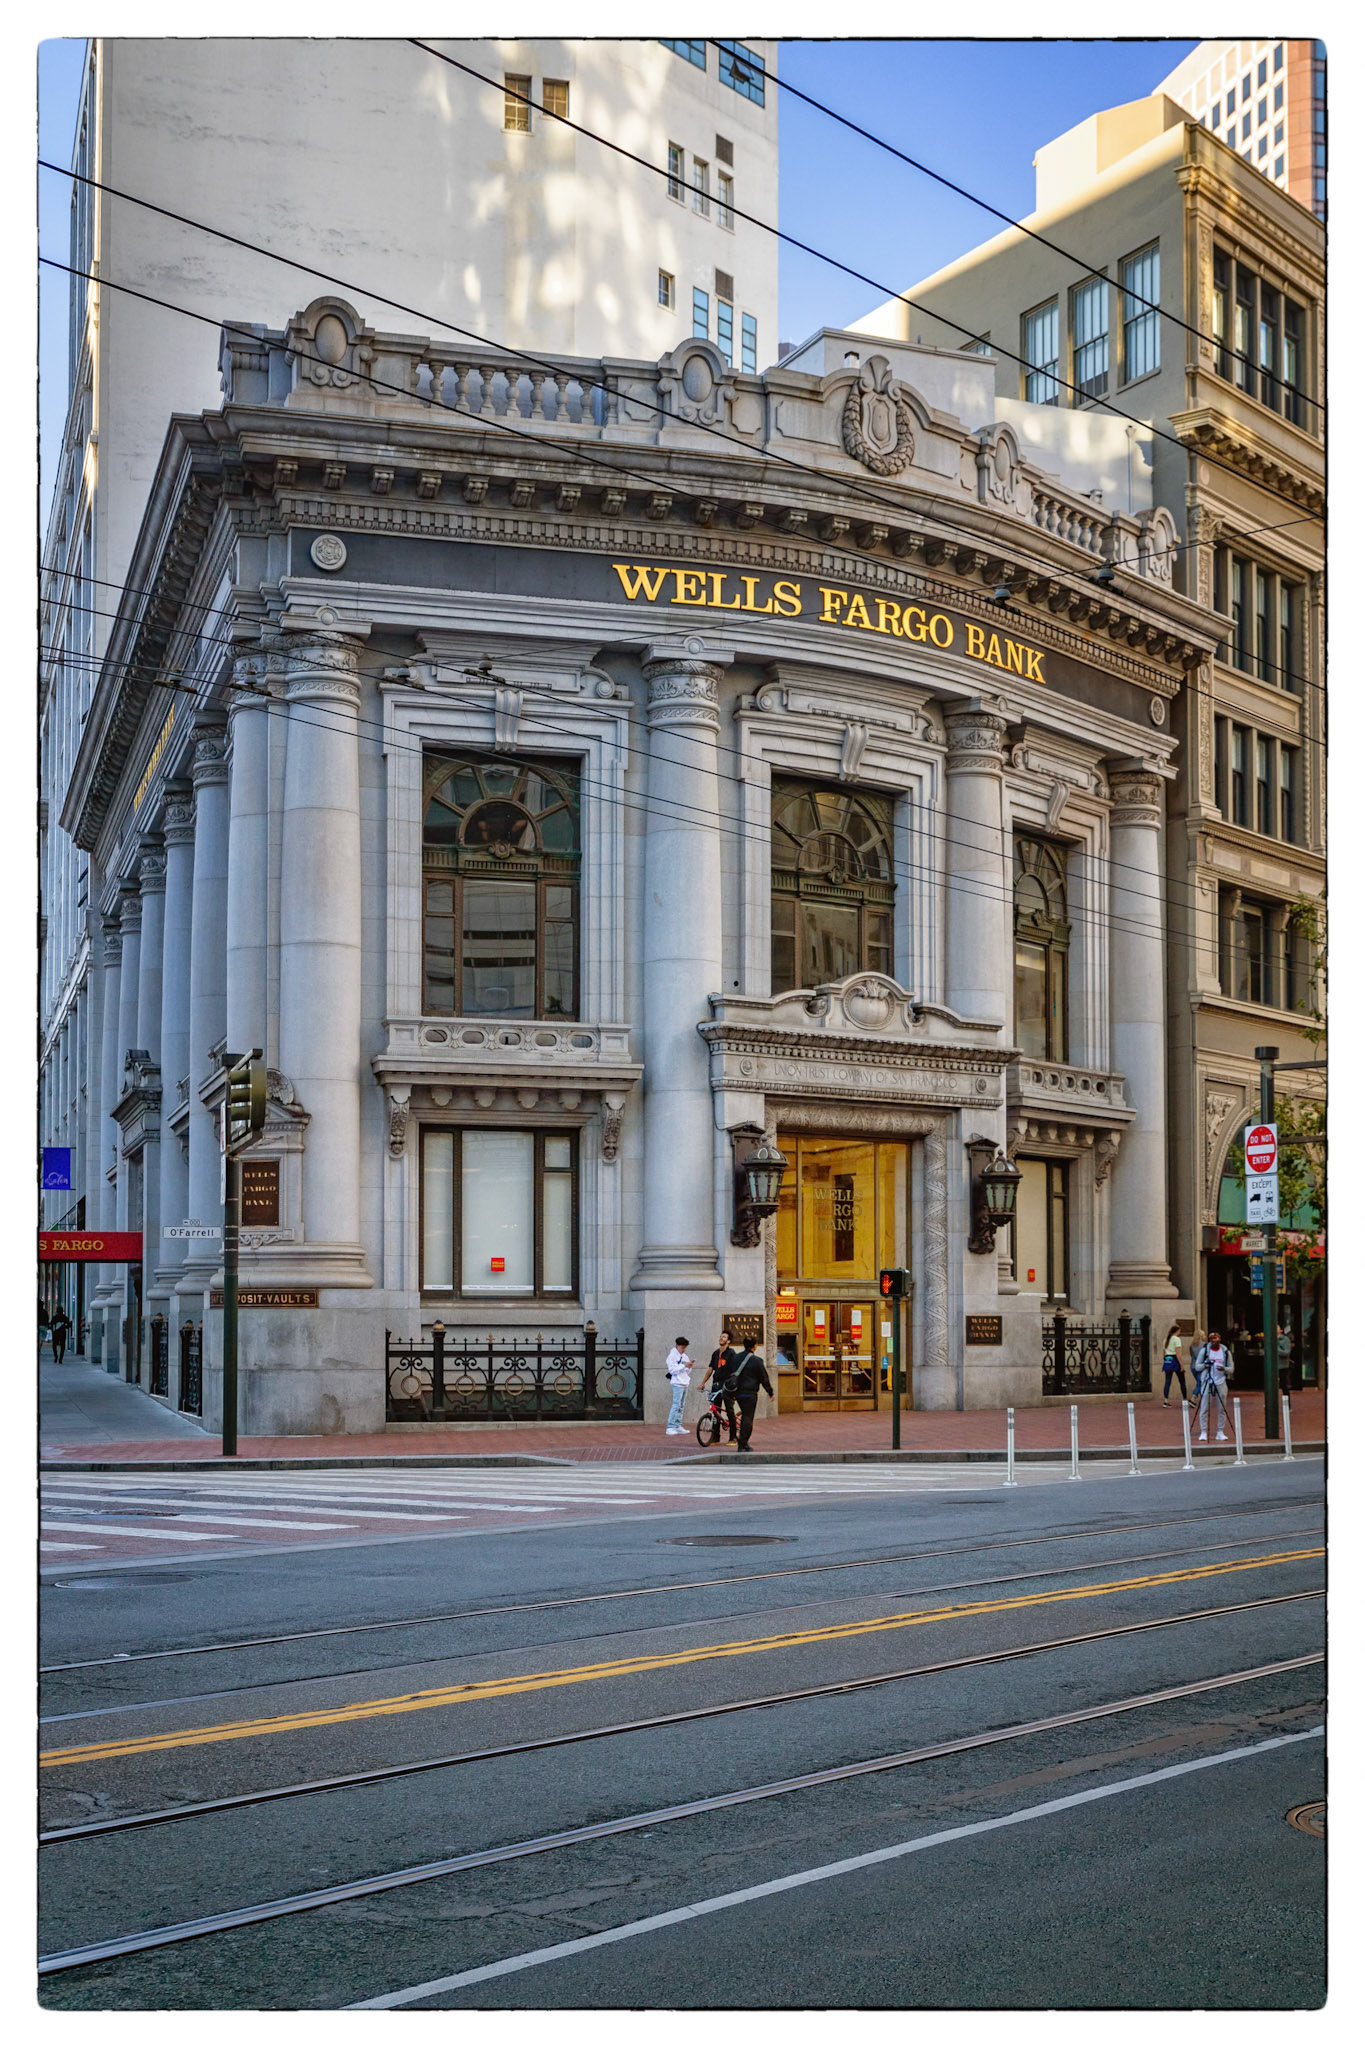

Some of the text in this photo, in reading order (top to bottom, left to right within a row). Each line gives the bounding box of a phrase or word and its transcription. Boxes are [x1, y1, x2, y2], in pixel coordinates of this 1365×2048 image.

[612, 564, 1047, 684] WELLS FARGO BANK
[774, 1063, 957, 1089] UNION TRUST COMPANY OF SAN FRANCISCO
[1250, 1134, 1273, 1144] DO NOT
[1252, 1155, 1270, 1165] ENTER
[1252, 1181, 1272, 1189] EXCEPT
[814, 1188, 864, 1202] WELLS
[170, 1228, 214, 1237] O'Farrell
[52, 1240, 104, 1251] FARGO
[1245, 1240, 1263, 1248] MARKET
